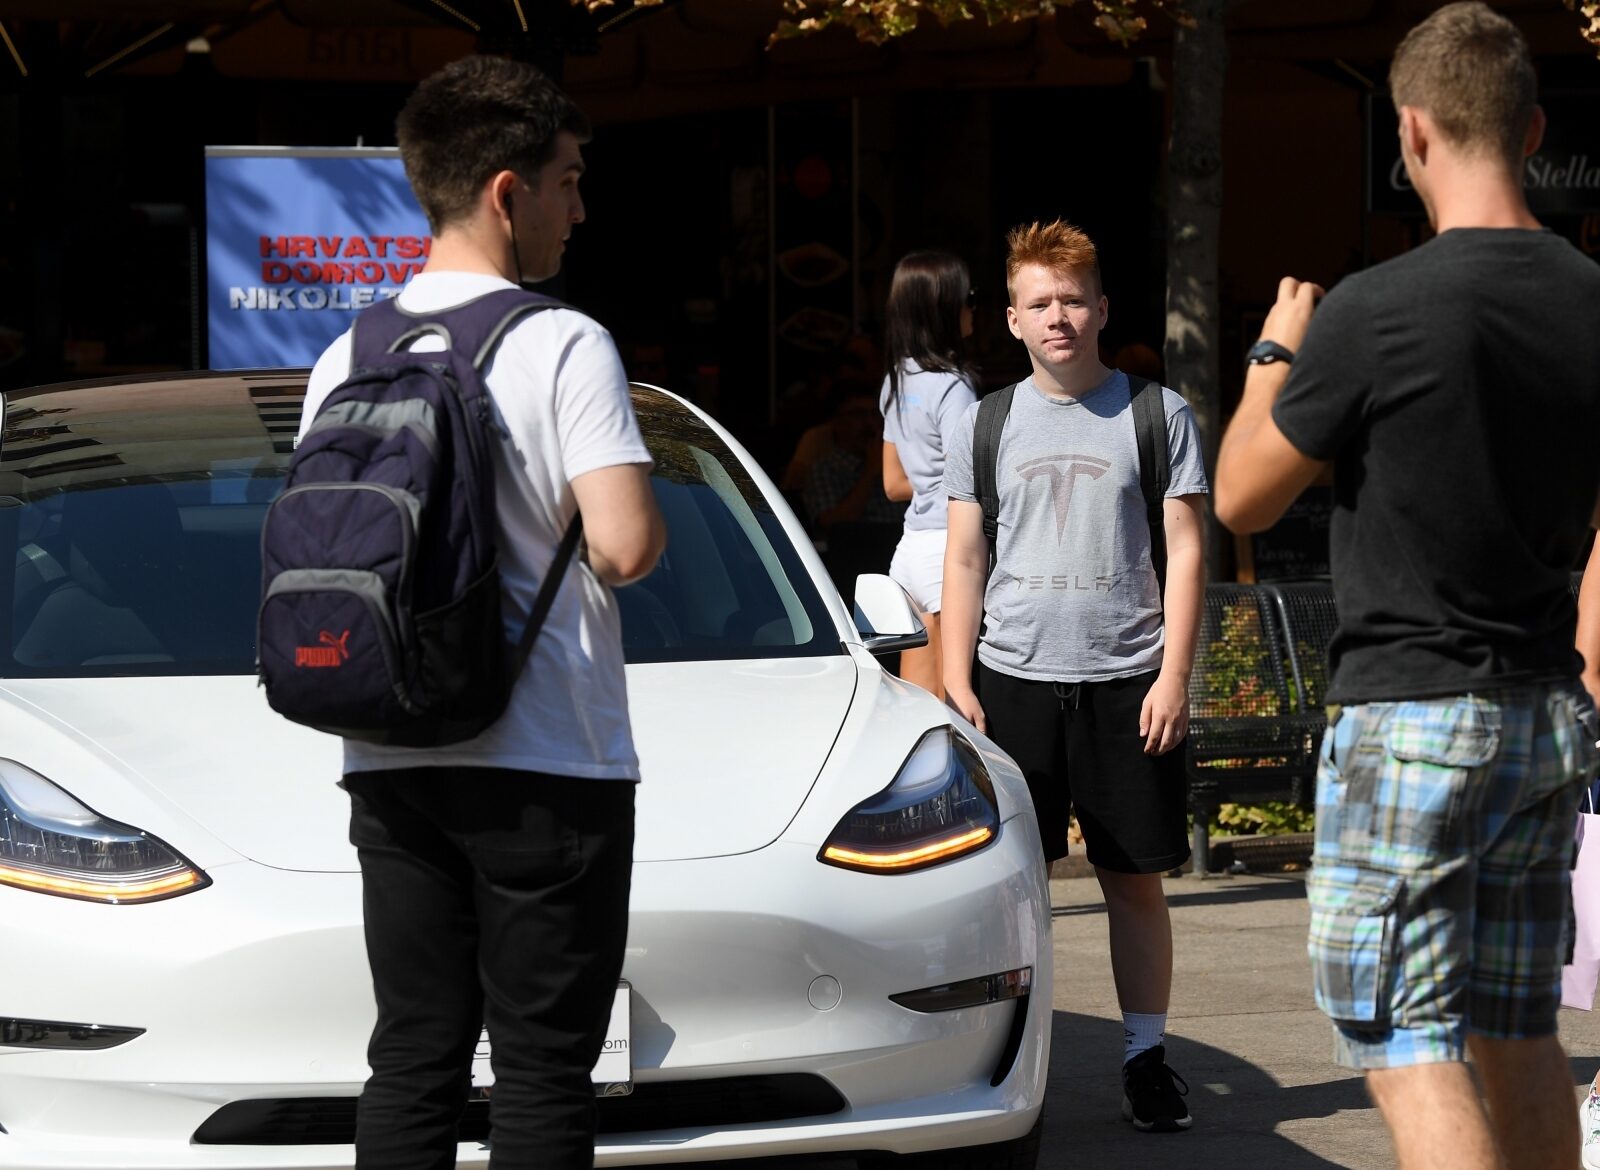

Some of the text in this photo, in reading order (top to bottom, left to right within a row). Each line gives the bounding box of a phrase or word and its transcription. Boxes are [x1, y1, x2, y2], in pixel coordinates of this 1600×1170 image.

[1523, 155, 1600, 188] Stella
[1012, 575, 1112, 592] TESLA
[296, 646, 341, 667] PUMA
